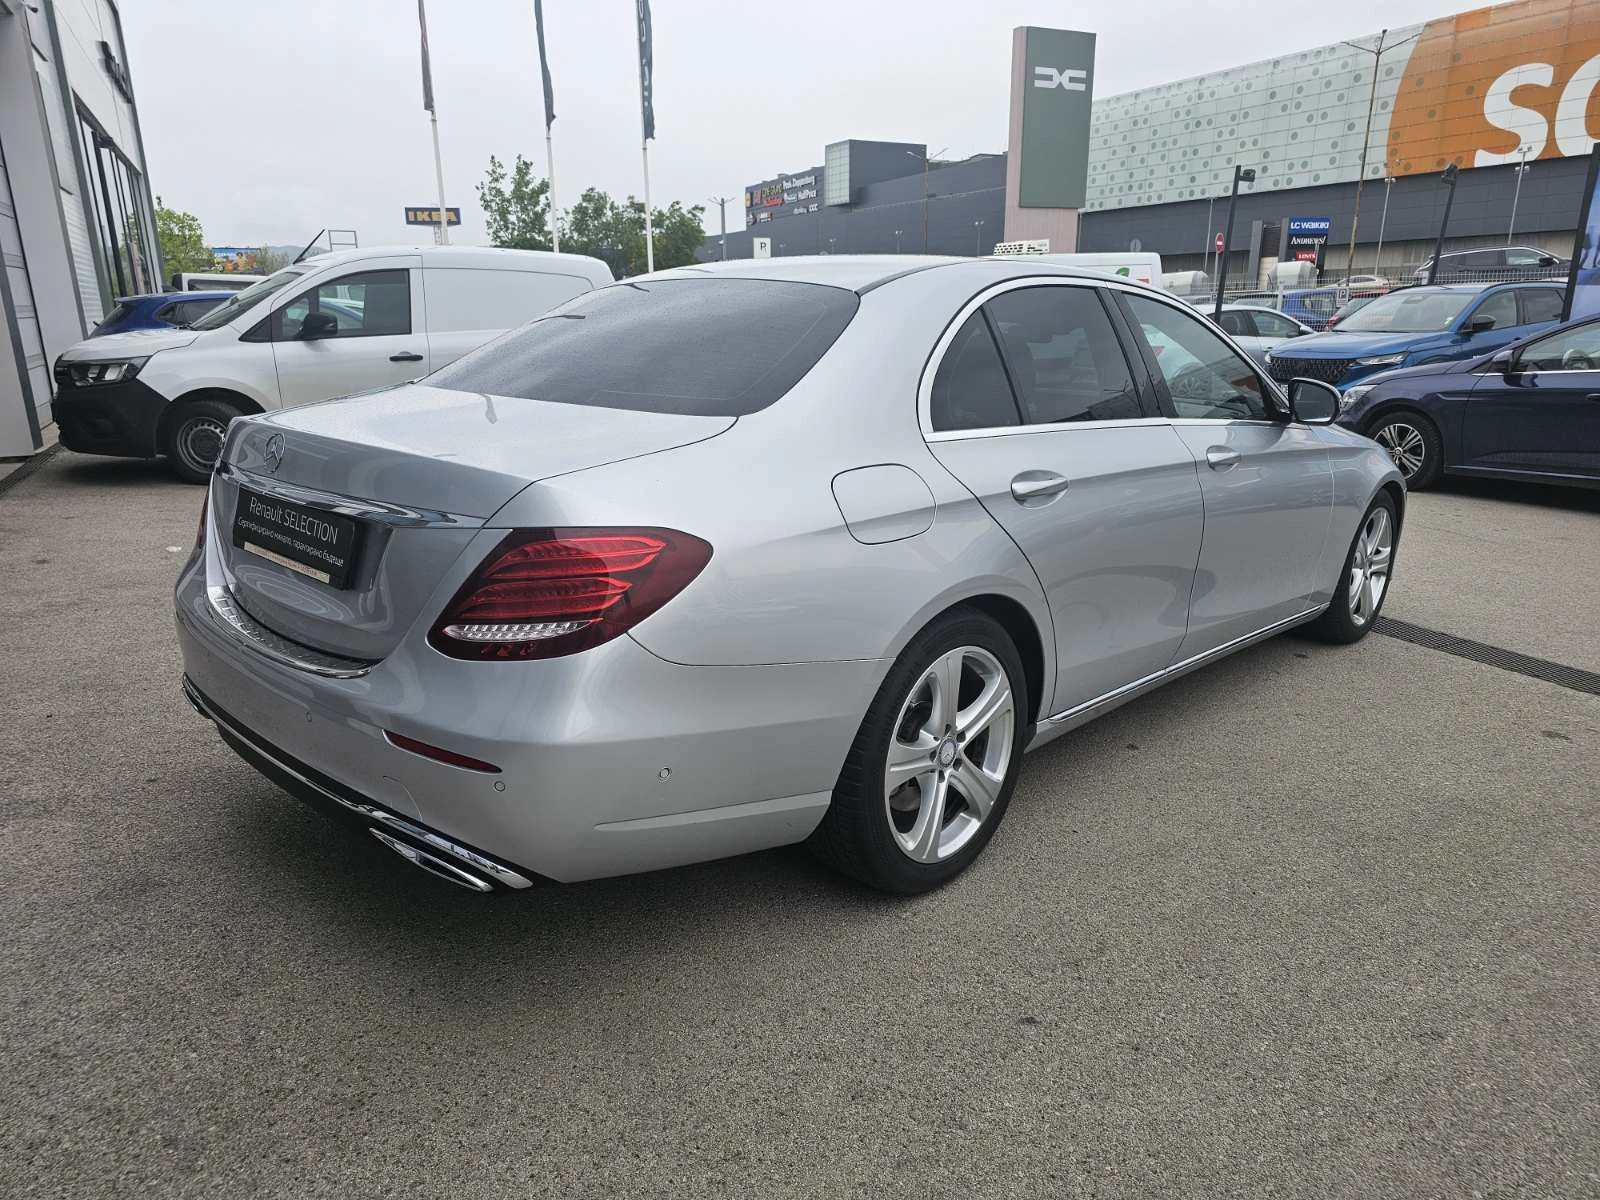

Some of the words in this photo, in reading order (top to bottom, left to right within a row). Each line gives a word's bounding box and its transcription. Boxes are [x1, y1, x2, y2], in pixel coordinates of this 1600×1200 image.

[407, 210, 457, 222] IKEA
[1290, 221, 1301, 229] LC
[249, 496, 283, 524] Renault
[283, 508, 339, 545] SELECTION
